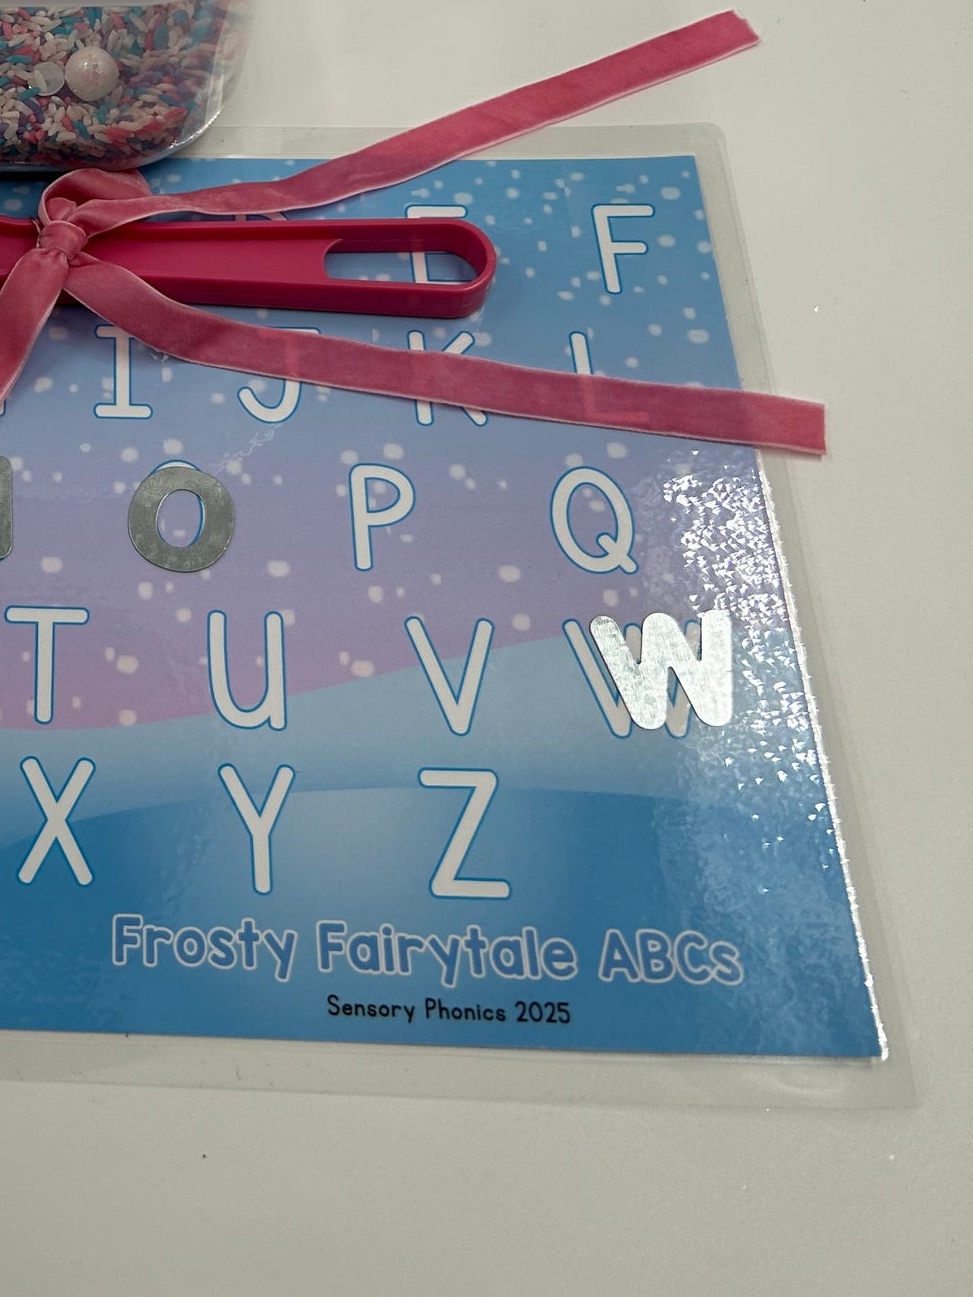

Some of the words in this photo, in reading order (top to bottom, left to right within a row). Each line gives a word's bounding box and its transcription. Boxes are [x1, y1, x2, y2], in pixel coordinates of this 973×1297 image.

[591, 203, 655, 294] F
[93, 324, 154, 420] I
[128, 459, 236, 573] O
[348, 463, 416, 571] P
[550, 466, 638, 574] Q
[4, 605, 90, 724] T
[207, 610, 287, 731] U
[403, 616, 494, 737] V
[589, 609, 733, 730] W
[16, 755, 96, 886] X
[217, 763, 296, 895] Y
[418, 767, 513, 900] Z
[112, 913, 298, 982] Frosty
[315, 920, 578, 988] Fairytale
[598, 928, 744, 985] ABCs
[326, 994, 415, 1023] Sensory
[424, 997, 506, 1023] Phonics
[515, 1000, 571, 1024] 2025
